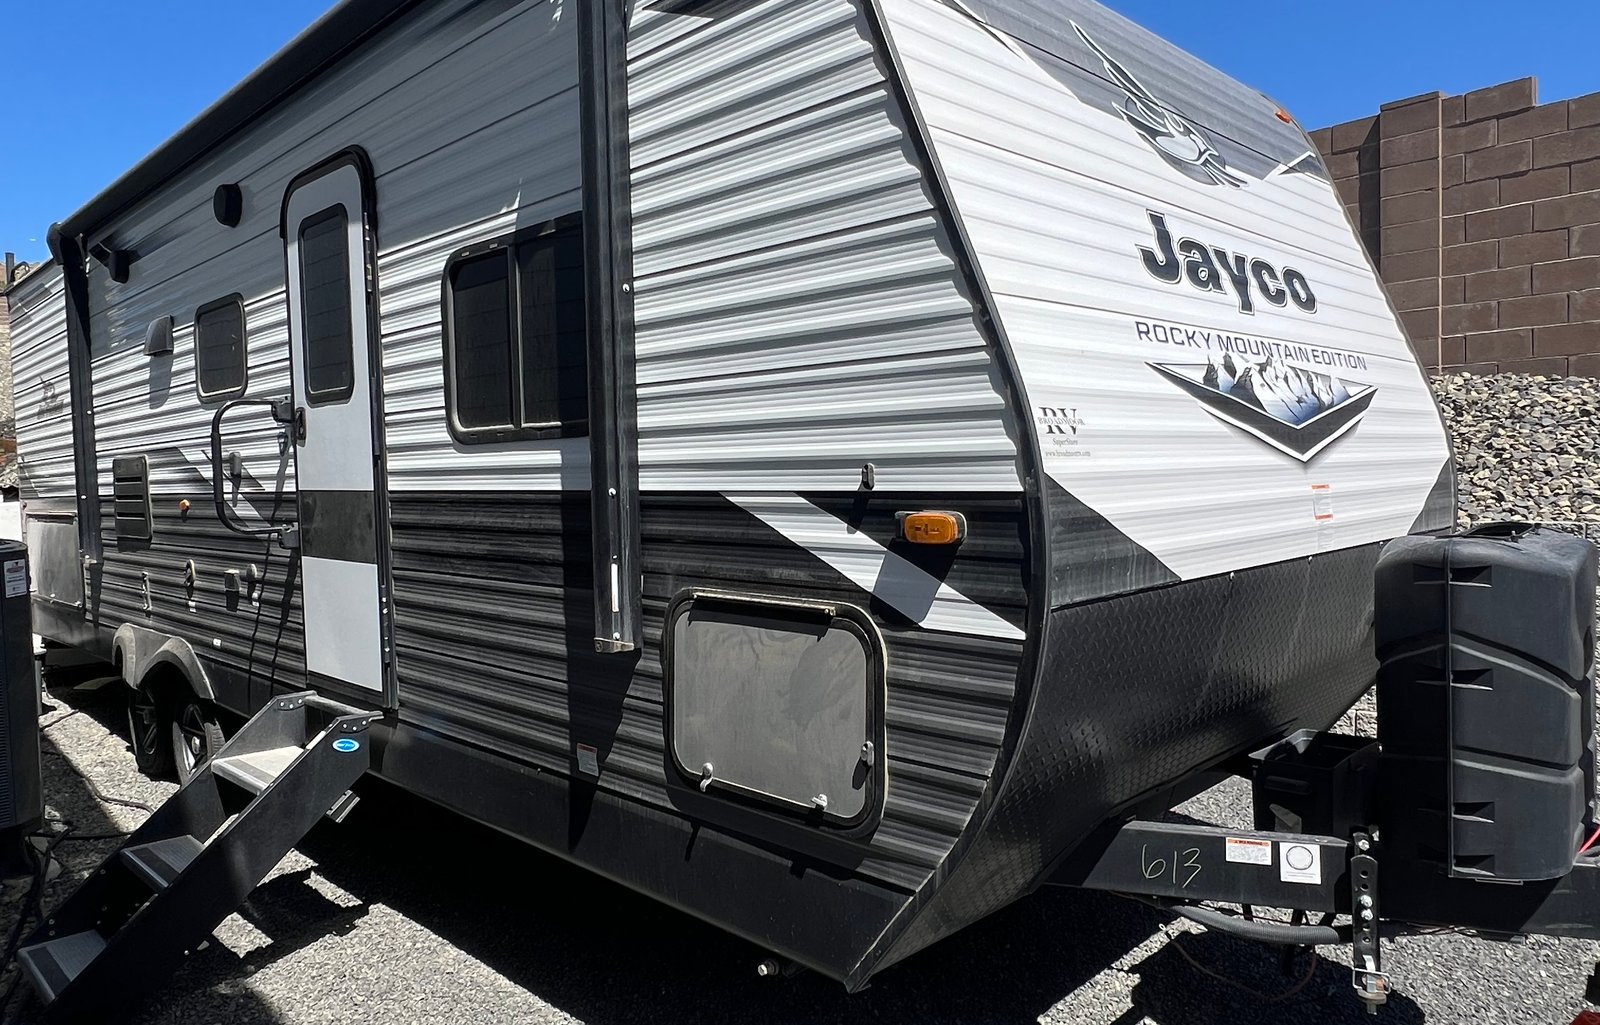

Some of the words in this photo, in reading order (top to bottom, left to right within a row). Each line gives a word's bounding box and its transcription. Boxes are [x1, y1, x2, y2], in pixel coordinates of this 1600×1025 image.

[1135, 208, 1317, 316] Jayco
[1135, 321, 1211, 350] ROCKY
[1216, 334, 1310, 363] MOUNTAIN
[1311, 349, 1368, 371] EDITION
[1037, 416, 1086, 426] BROADMOOR
[1038, 406, 1077, 435] RV
[1142, 843, 1202, 888] 613
